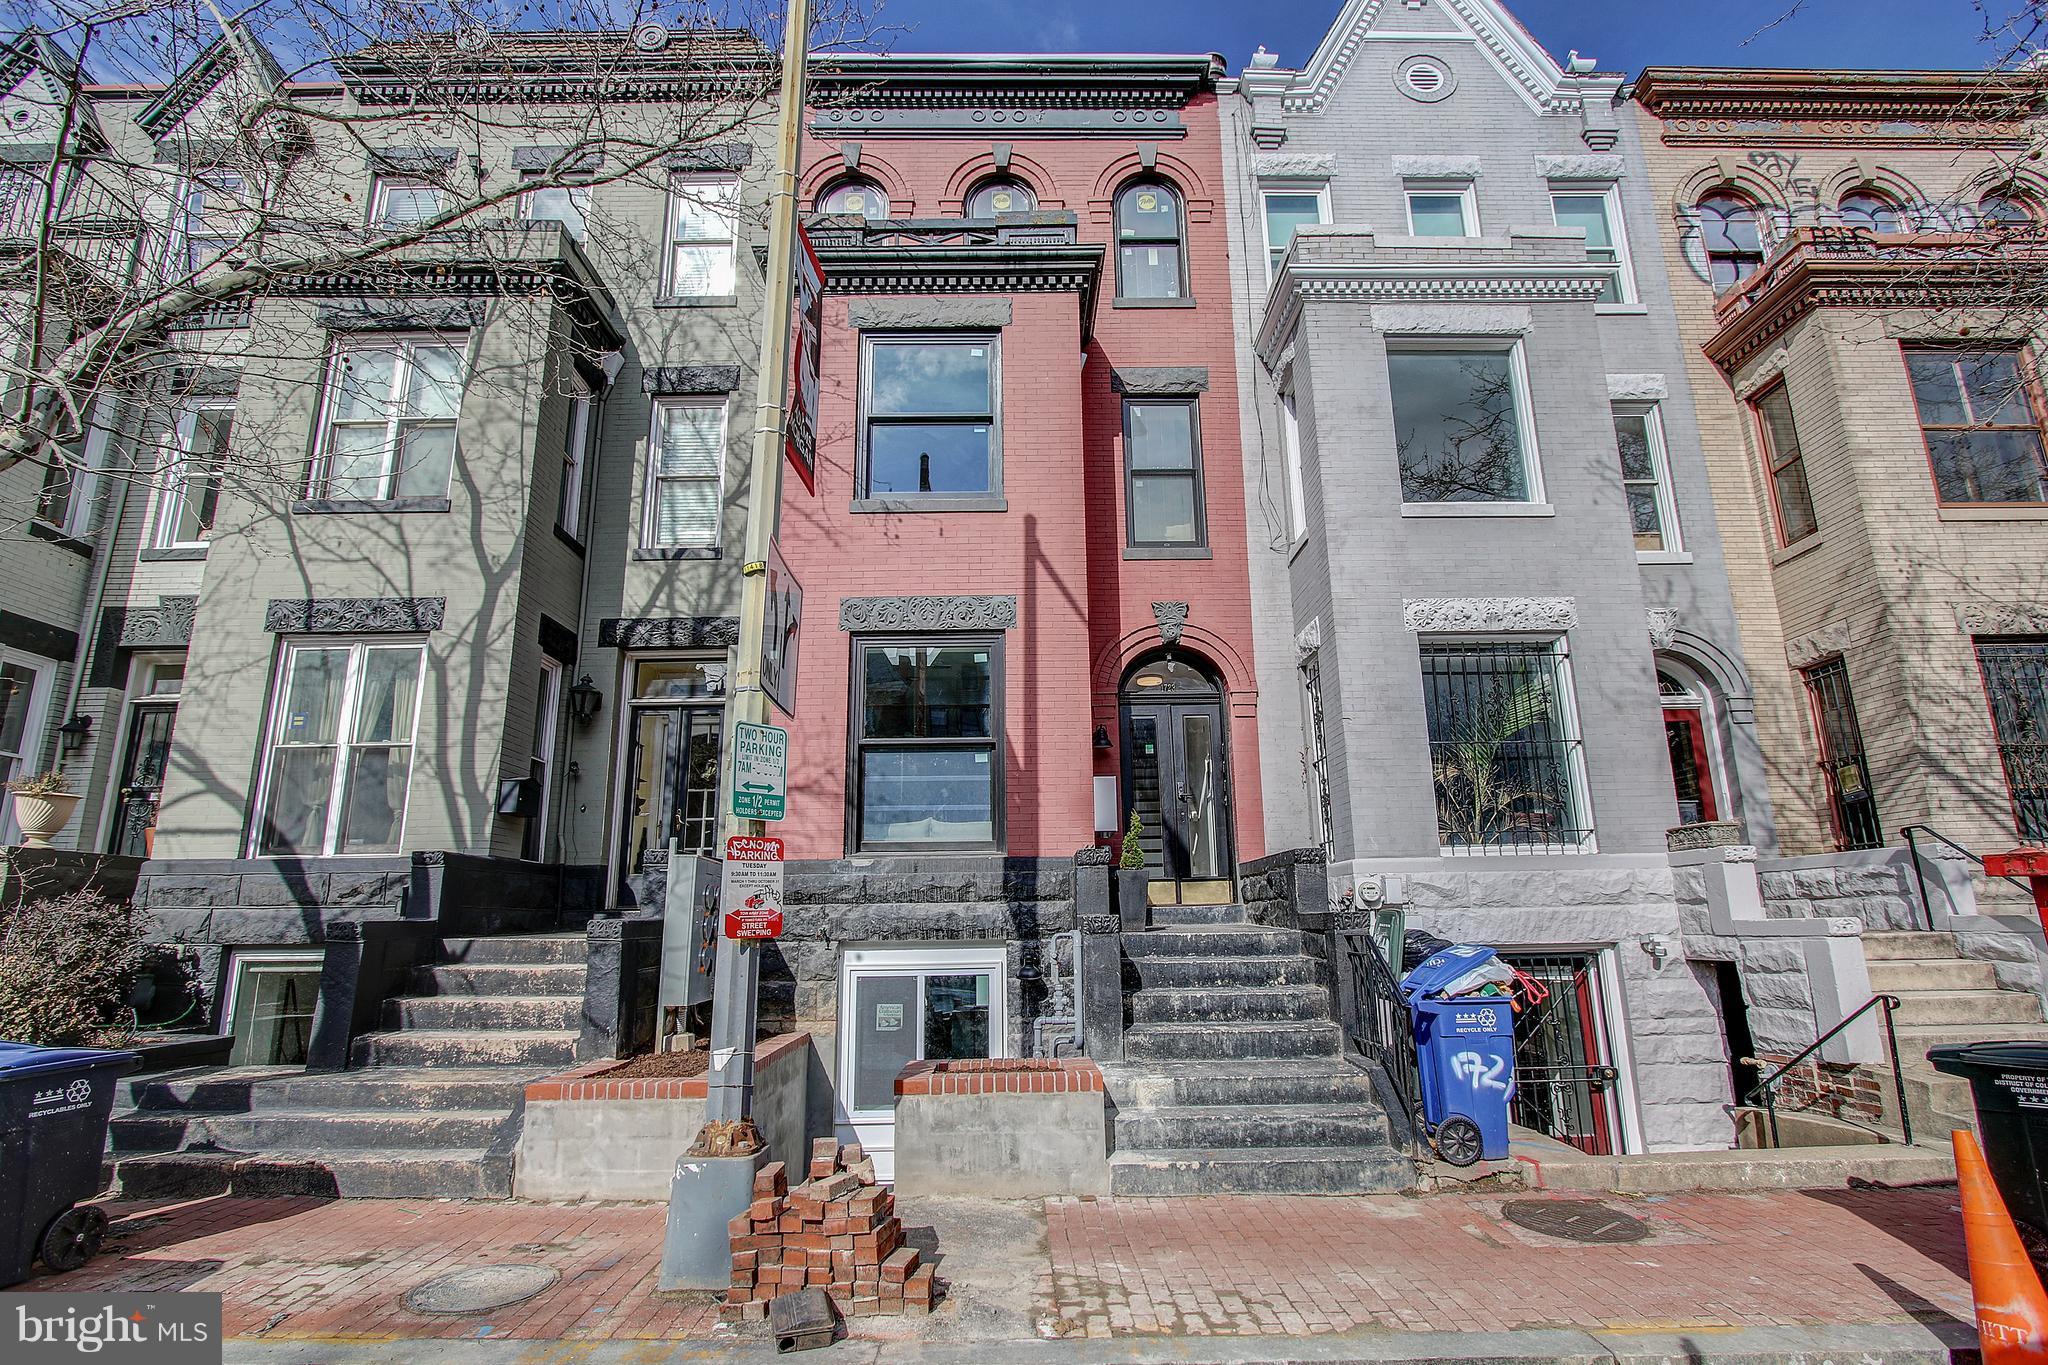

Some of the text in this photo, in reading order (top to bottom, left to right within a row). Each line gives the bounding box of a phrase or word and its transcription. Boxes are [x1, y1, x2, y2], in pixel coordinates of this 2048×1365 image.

[763, 652, 779, 690] ONLY
[739, 727, 784, 745] TWO HOUR
[740, 741, 782, 758] PARKING
[738, 794, 780, 808] ZONE 1/2 PERMIT
[735, 807, 783, 818] HOLDERS CEPTED
[749, 839, 764, 850] NO
[734, 850, 778, 861] PARKING
[741, 922, 768, 930] STREET
[28, 1101, 93, 1119] RECYCLABLES ONLY
